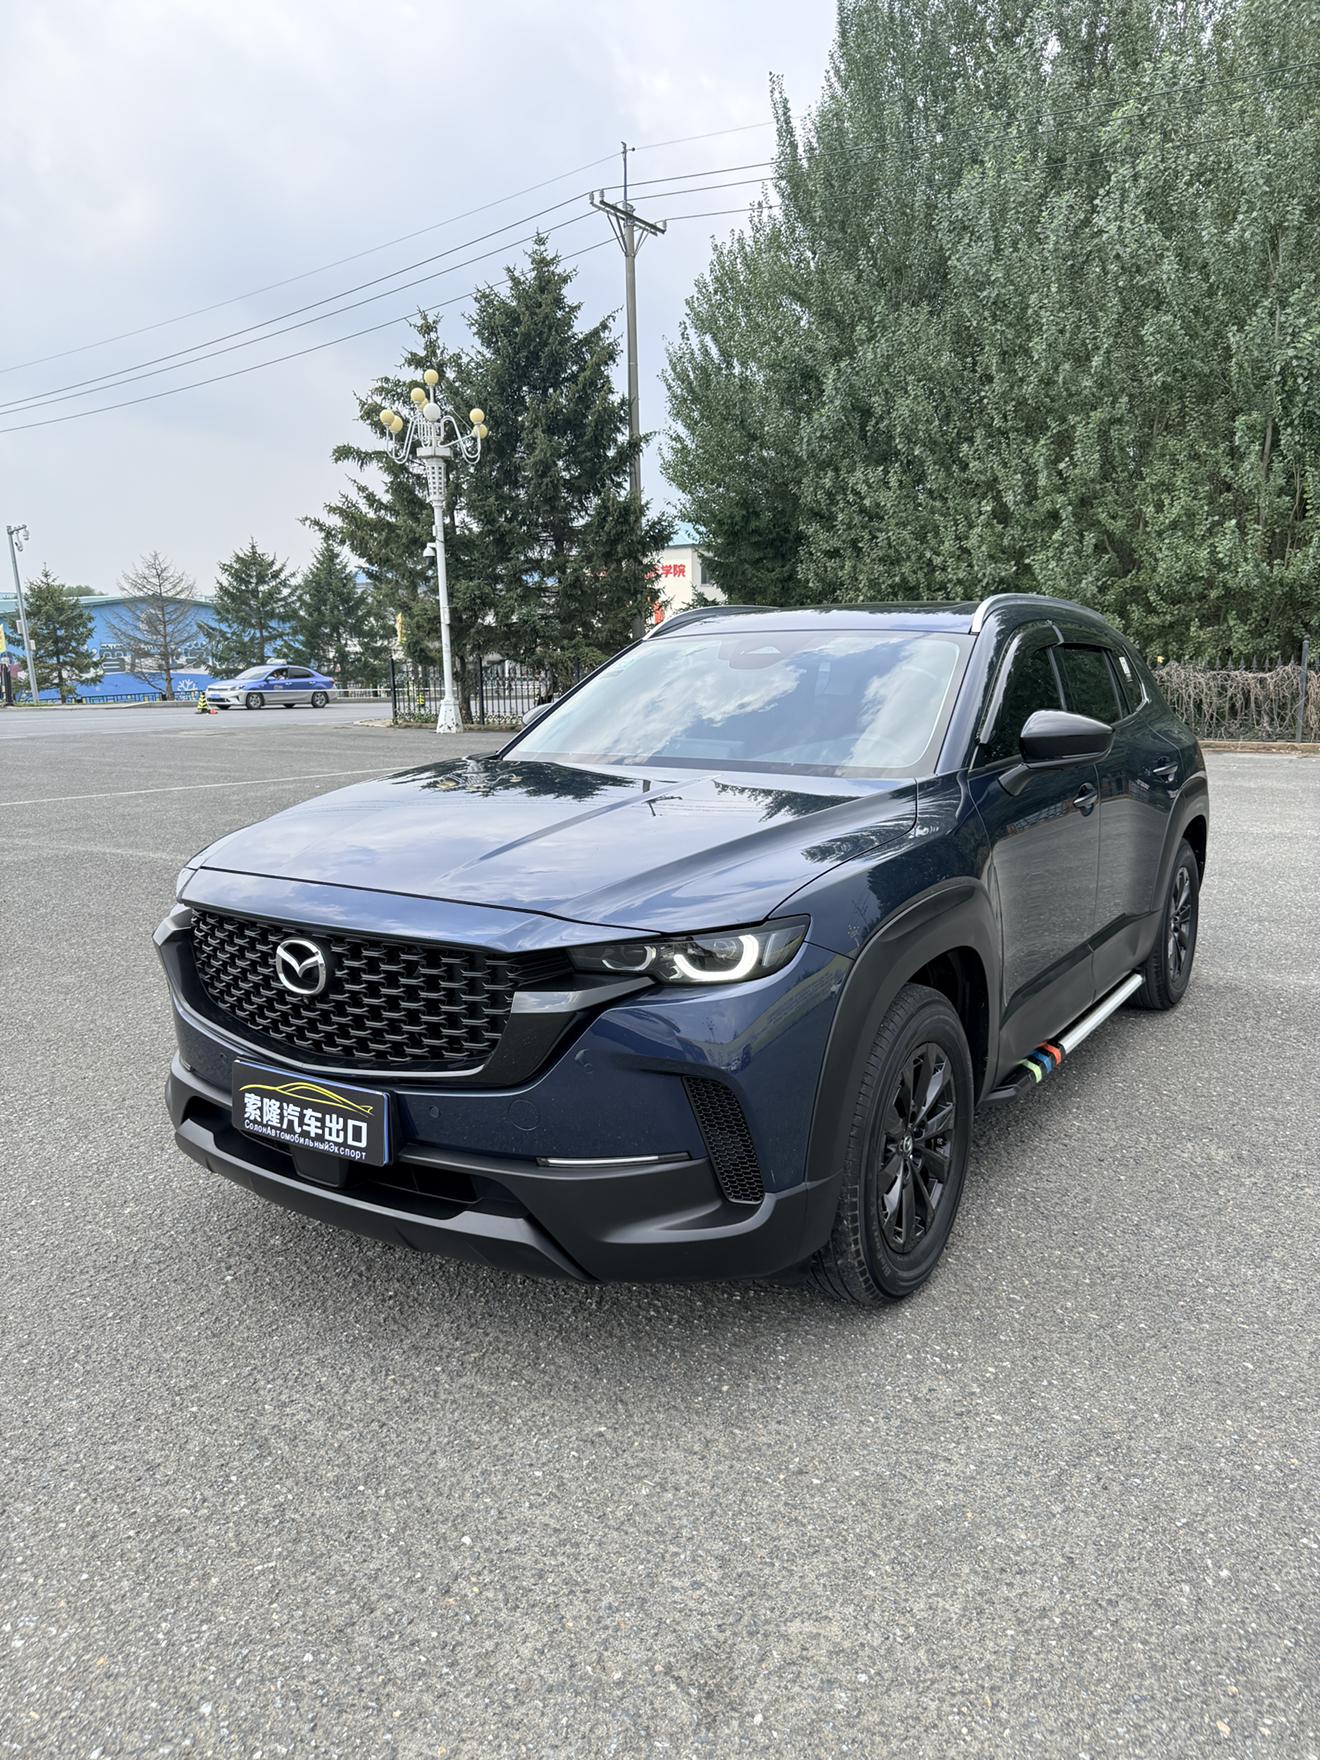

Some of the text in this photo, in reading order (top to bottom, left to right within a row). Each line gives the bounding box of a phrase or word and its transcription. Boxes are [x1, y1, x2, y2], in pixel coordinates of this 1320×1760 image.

[243, 1092, 368, 1148] 索隆汽车出口
